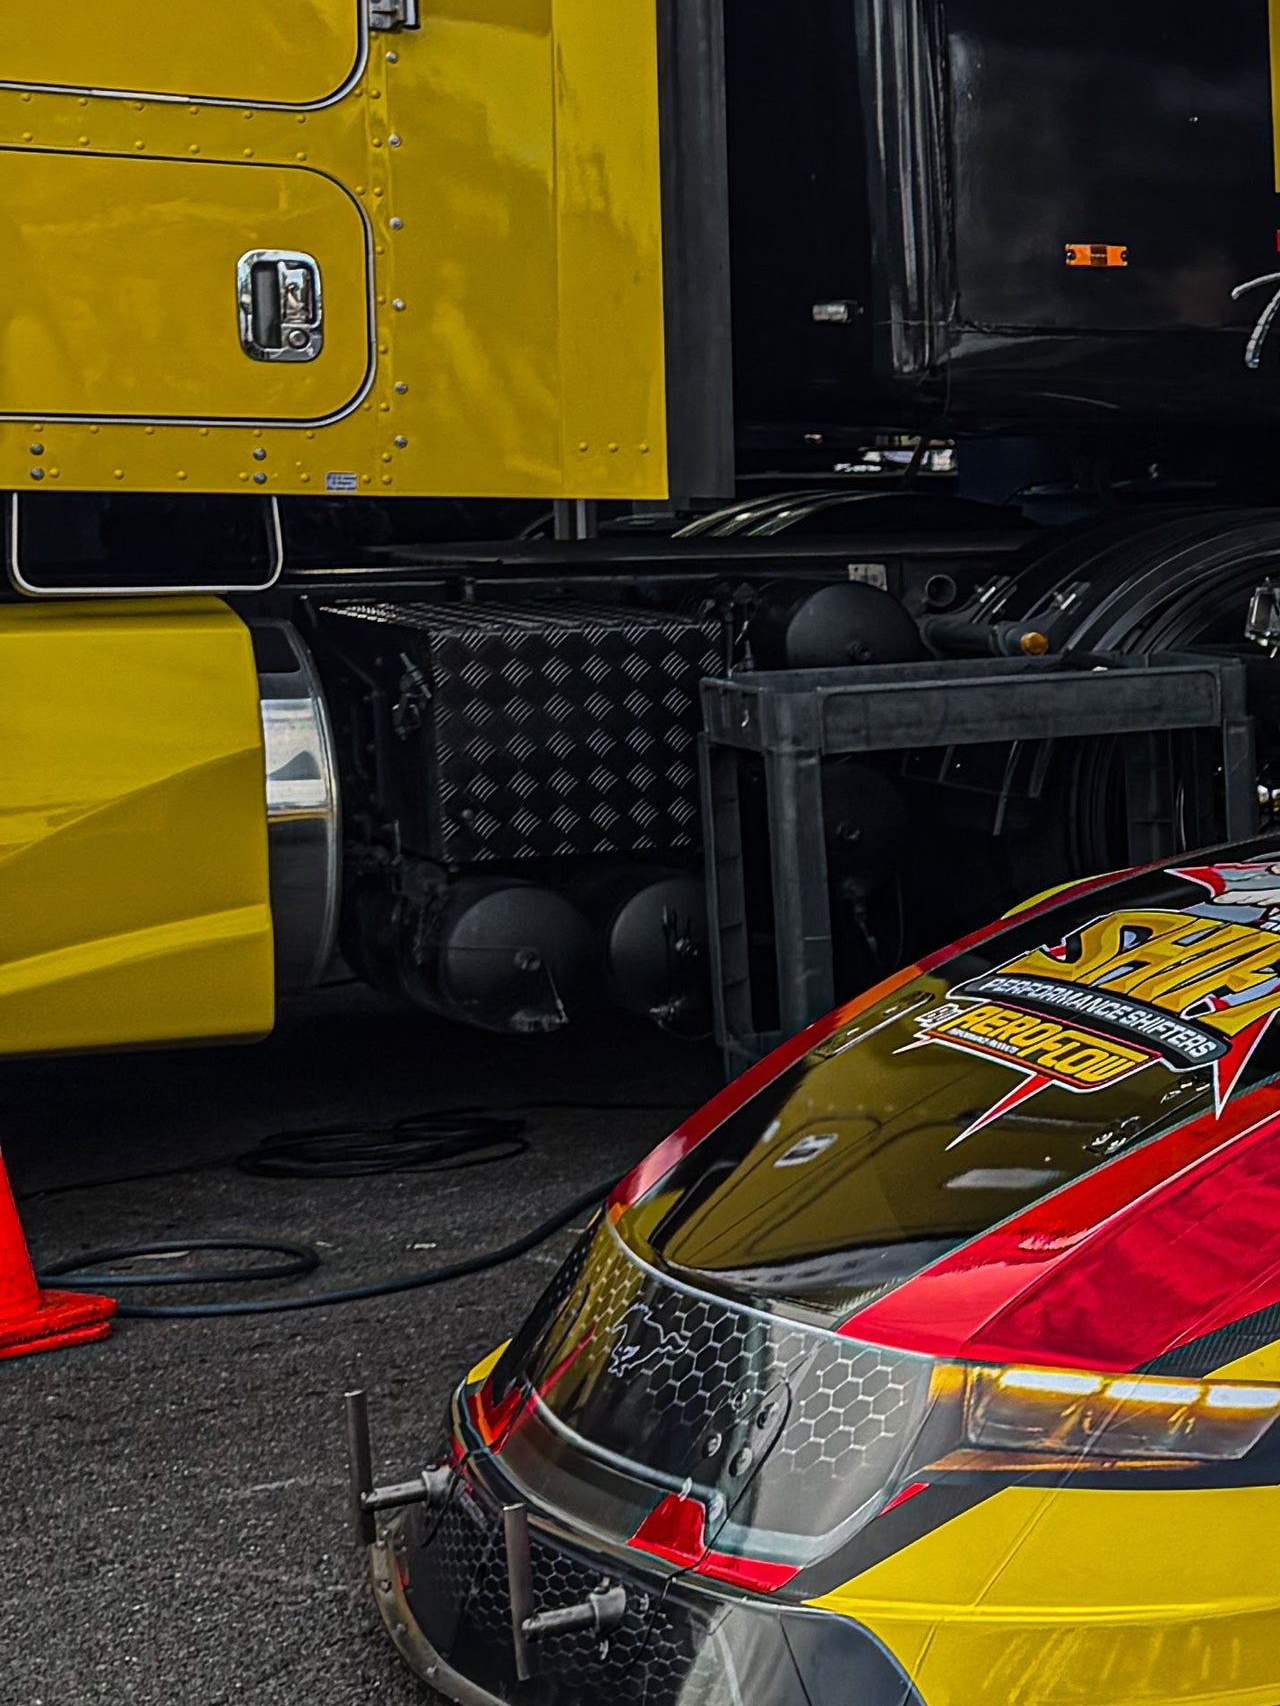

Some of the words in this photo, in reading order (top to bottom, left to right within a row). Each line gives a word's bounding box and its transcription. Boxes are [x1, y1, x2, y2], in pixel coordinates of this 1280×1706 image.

[937, 1005, 1151, 1083] AEROFLOW
[979, 976, 1125, 1025] PERFORMANCE
[1122, 1001, 1218, 1059] SHIFTERS
